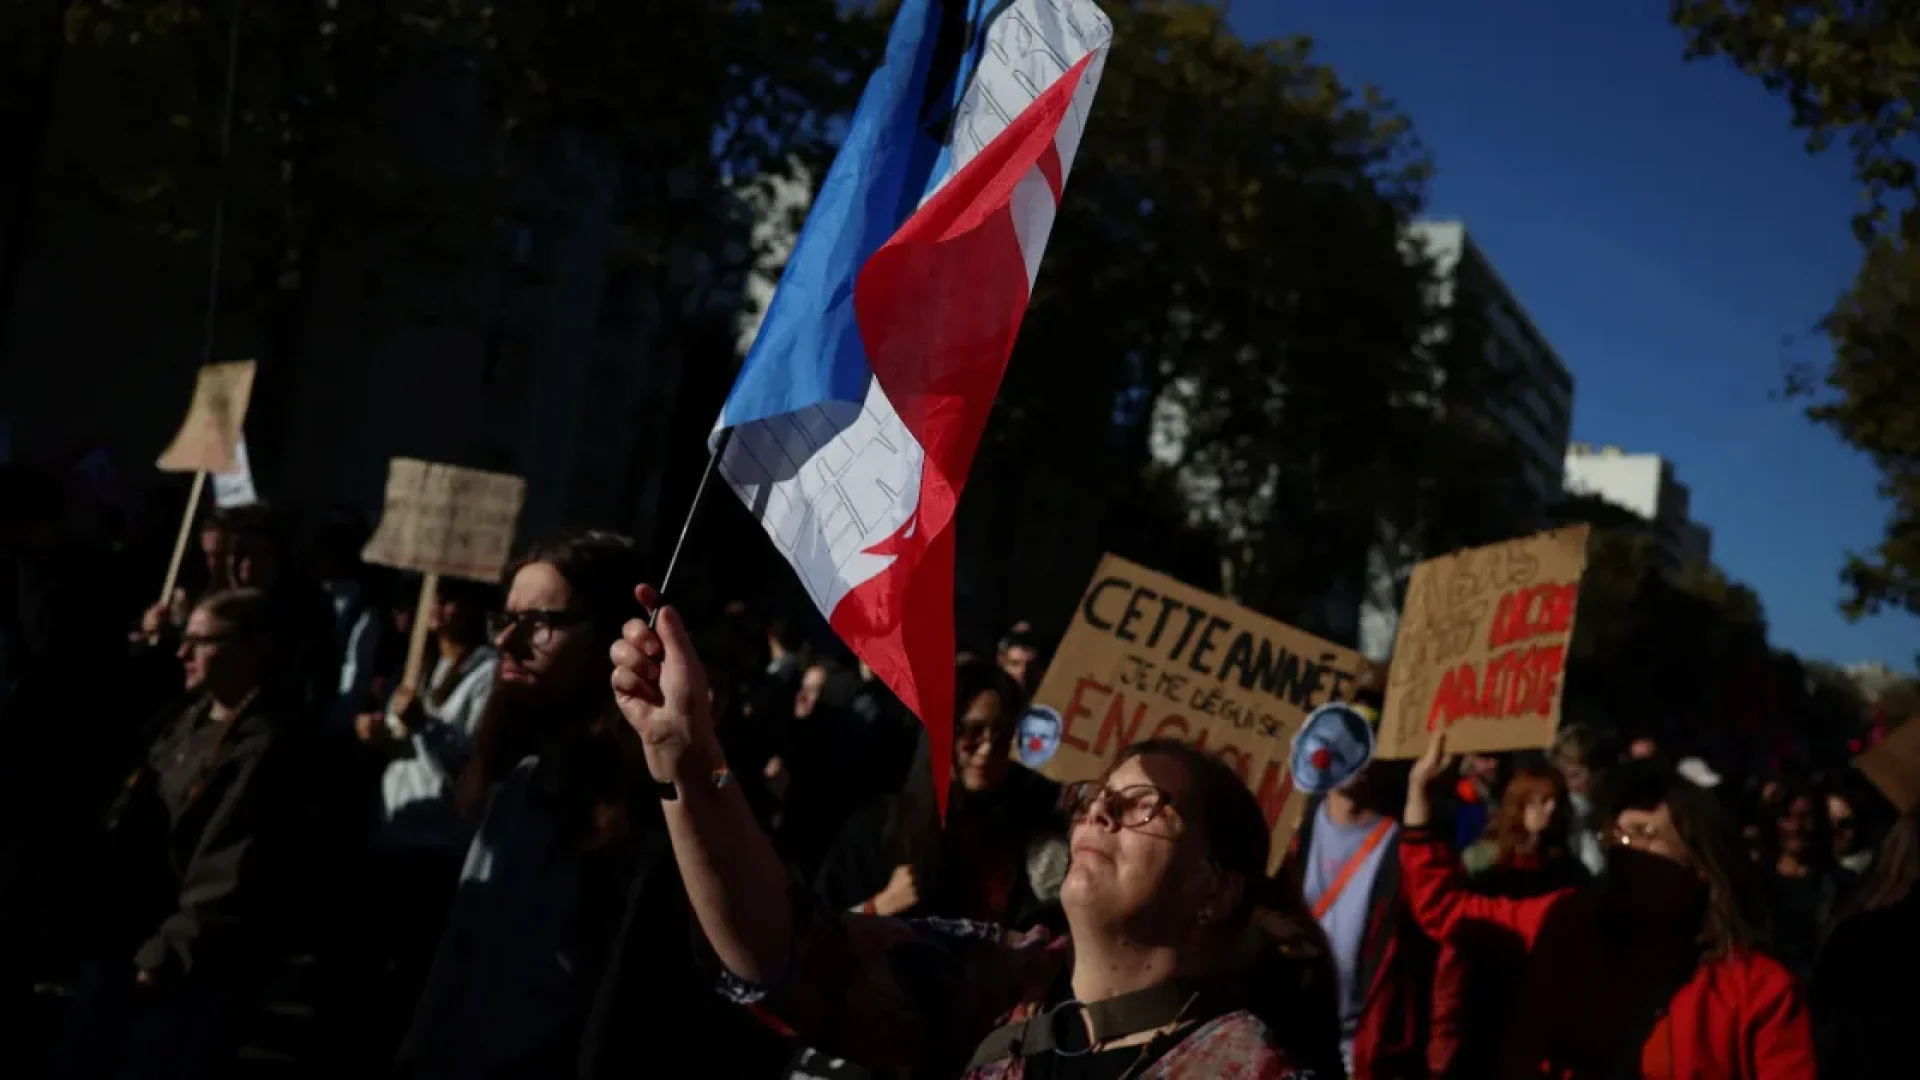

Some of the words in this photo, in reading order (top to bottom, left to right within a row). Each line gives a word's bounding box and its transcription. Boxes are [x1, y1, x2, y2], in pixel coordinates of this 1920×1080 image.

[1084, 576, 1231, 675] CETTE
[1062, 676, 1147, 755] EN
[1119, 653, 1154, 691] JE
[1154, 671, 1188, 702] ME
